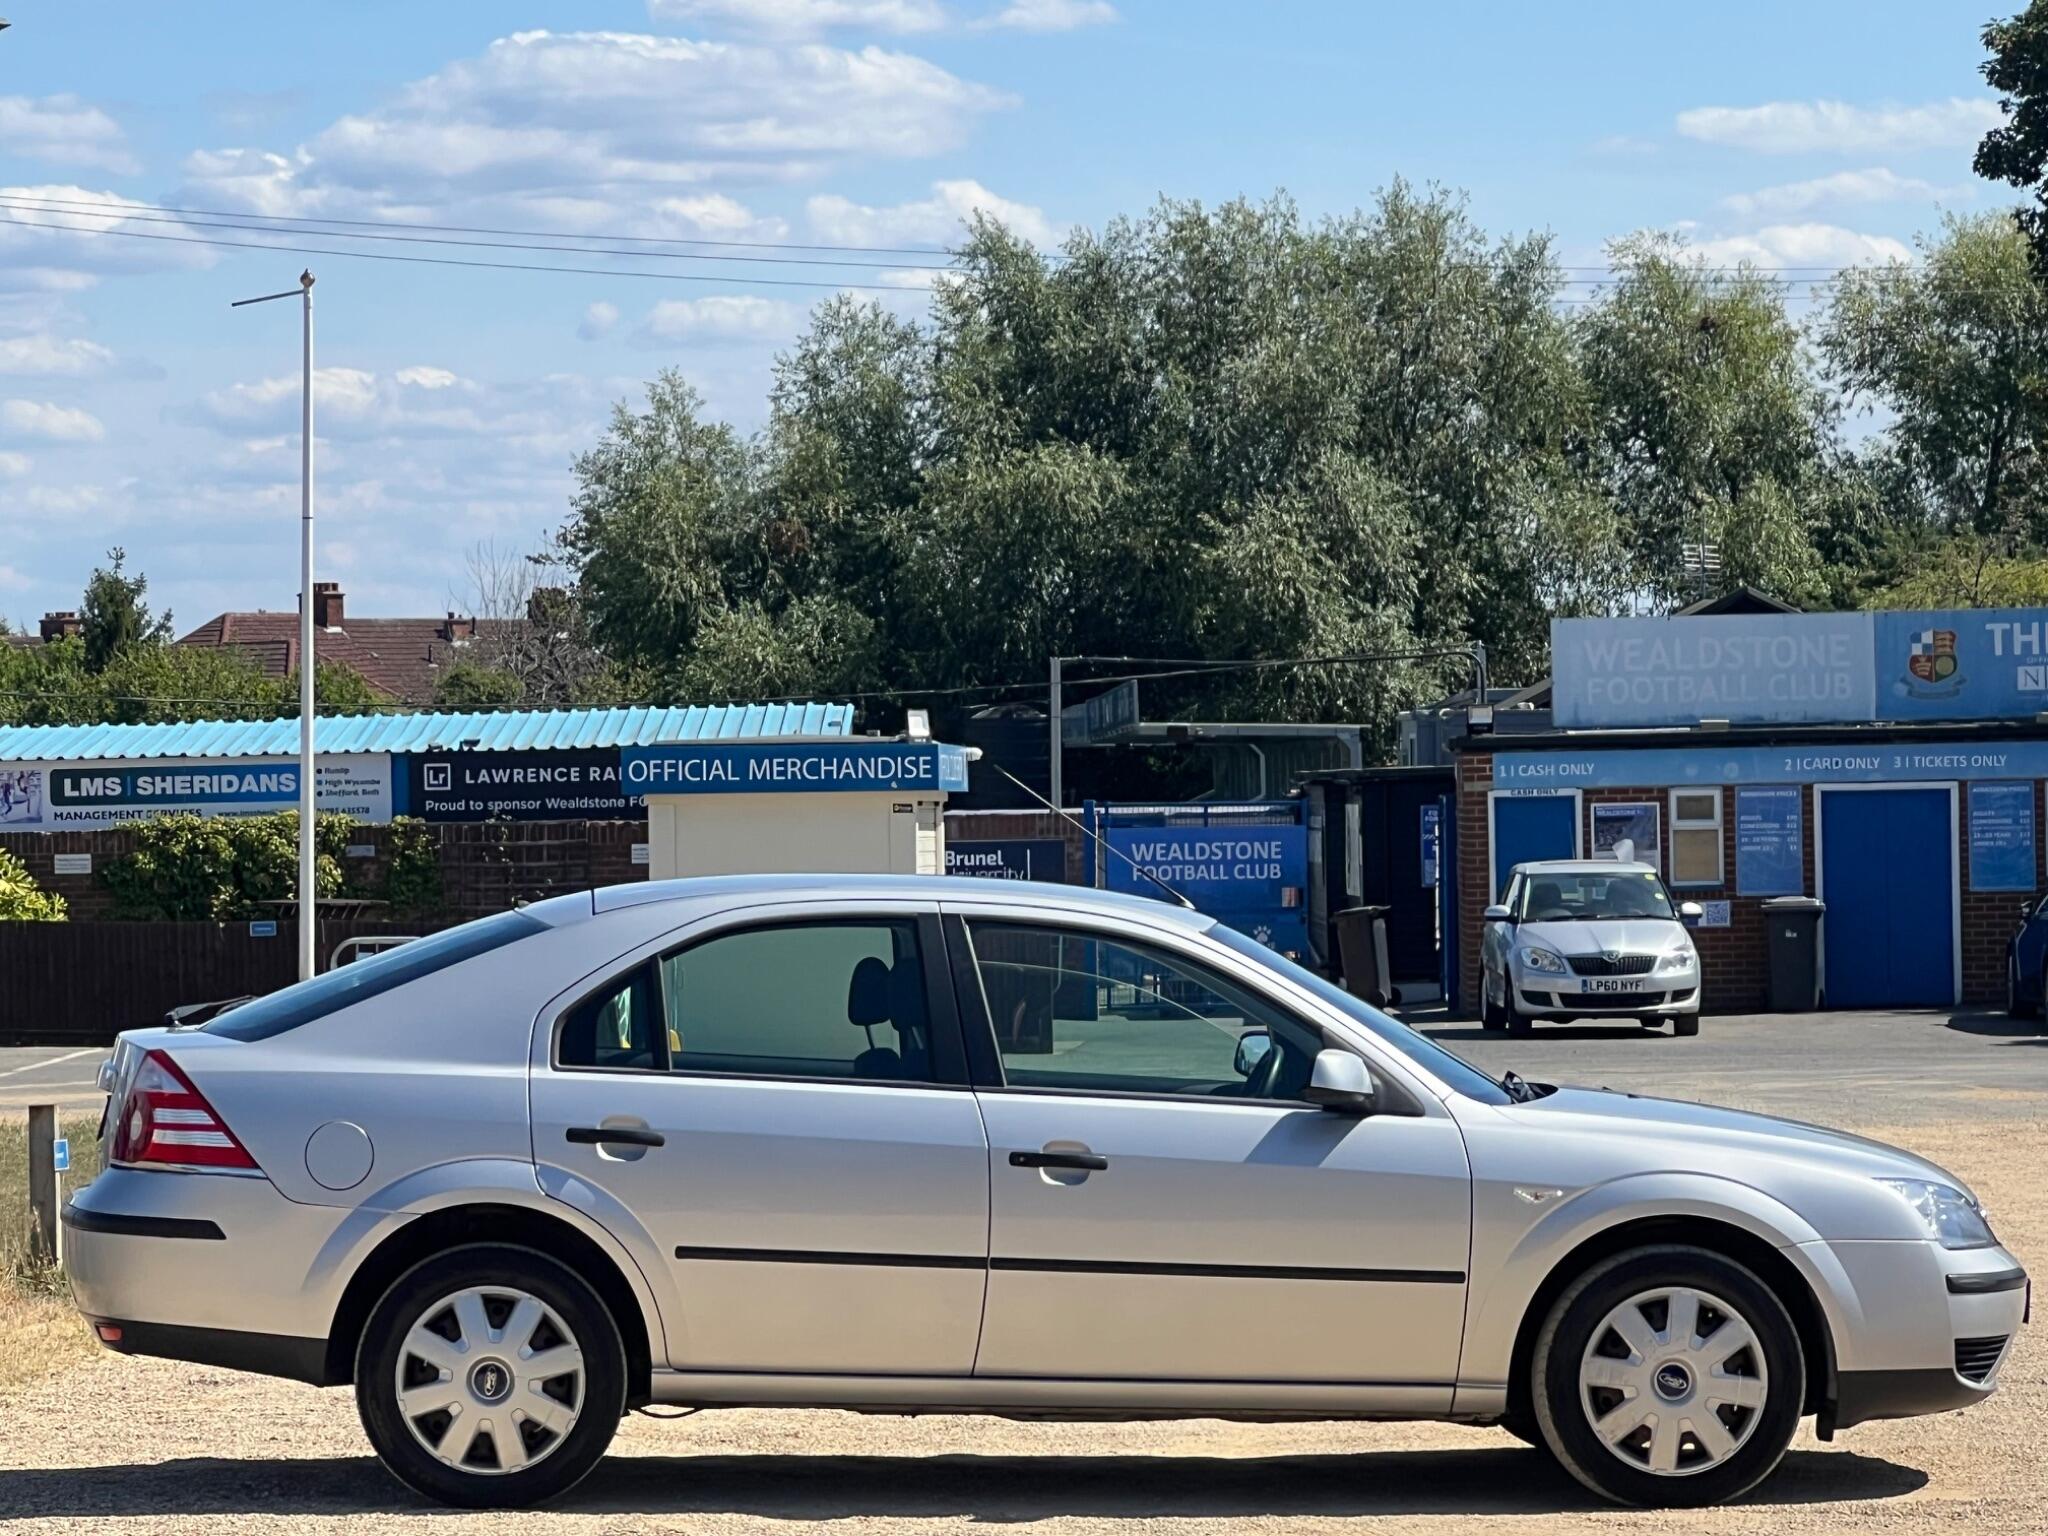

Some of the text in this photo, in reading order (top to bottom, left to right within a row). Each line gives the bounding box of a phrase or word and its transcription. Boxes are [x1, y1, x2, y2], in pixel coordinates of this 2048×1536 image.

[1584, 633, 1852, 672] WEALDSTONE
[1587, 672, 1852, 704] FOOTBALL CLUB
[628, 758, 739, 782] OFFICIAL
[749, 756, 932, 781] MERCHANDISE
[1518, 765, 1555, 776] CASH
[1559, 763, 1594, 775] ONLY
[1784, 759, 1792, 771] 2
[1803, 758, 1842, 770] CARD
[1845, 757, 1880, 769] ONLY
[1893, 757, 1901, 768] 3
[1914, 755, 1967, 768] TICKETS
[1971, 755, 2007, 767] ONLY
[465, 767, 580, 784] LAWRENCE
[63, 773, 297, 797] LMS SHERIDANS
[425, 800, 465, 812] Proud
[469, 801, 484, 811] to
[487, 801, 541, 813] sponsor
[546, 796, 626, 809] Wealdstone
[54, 809, 143, 821] MANAGEMENT
[945, 849, 1004, 867] Brunel
[1131, 841, 1282, 861] WEALDSTONE
[1133, 863, 1282, 882] FOOTBALL CLUB
[1589, 980, 1642, 992] LP60 NYF
